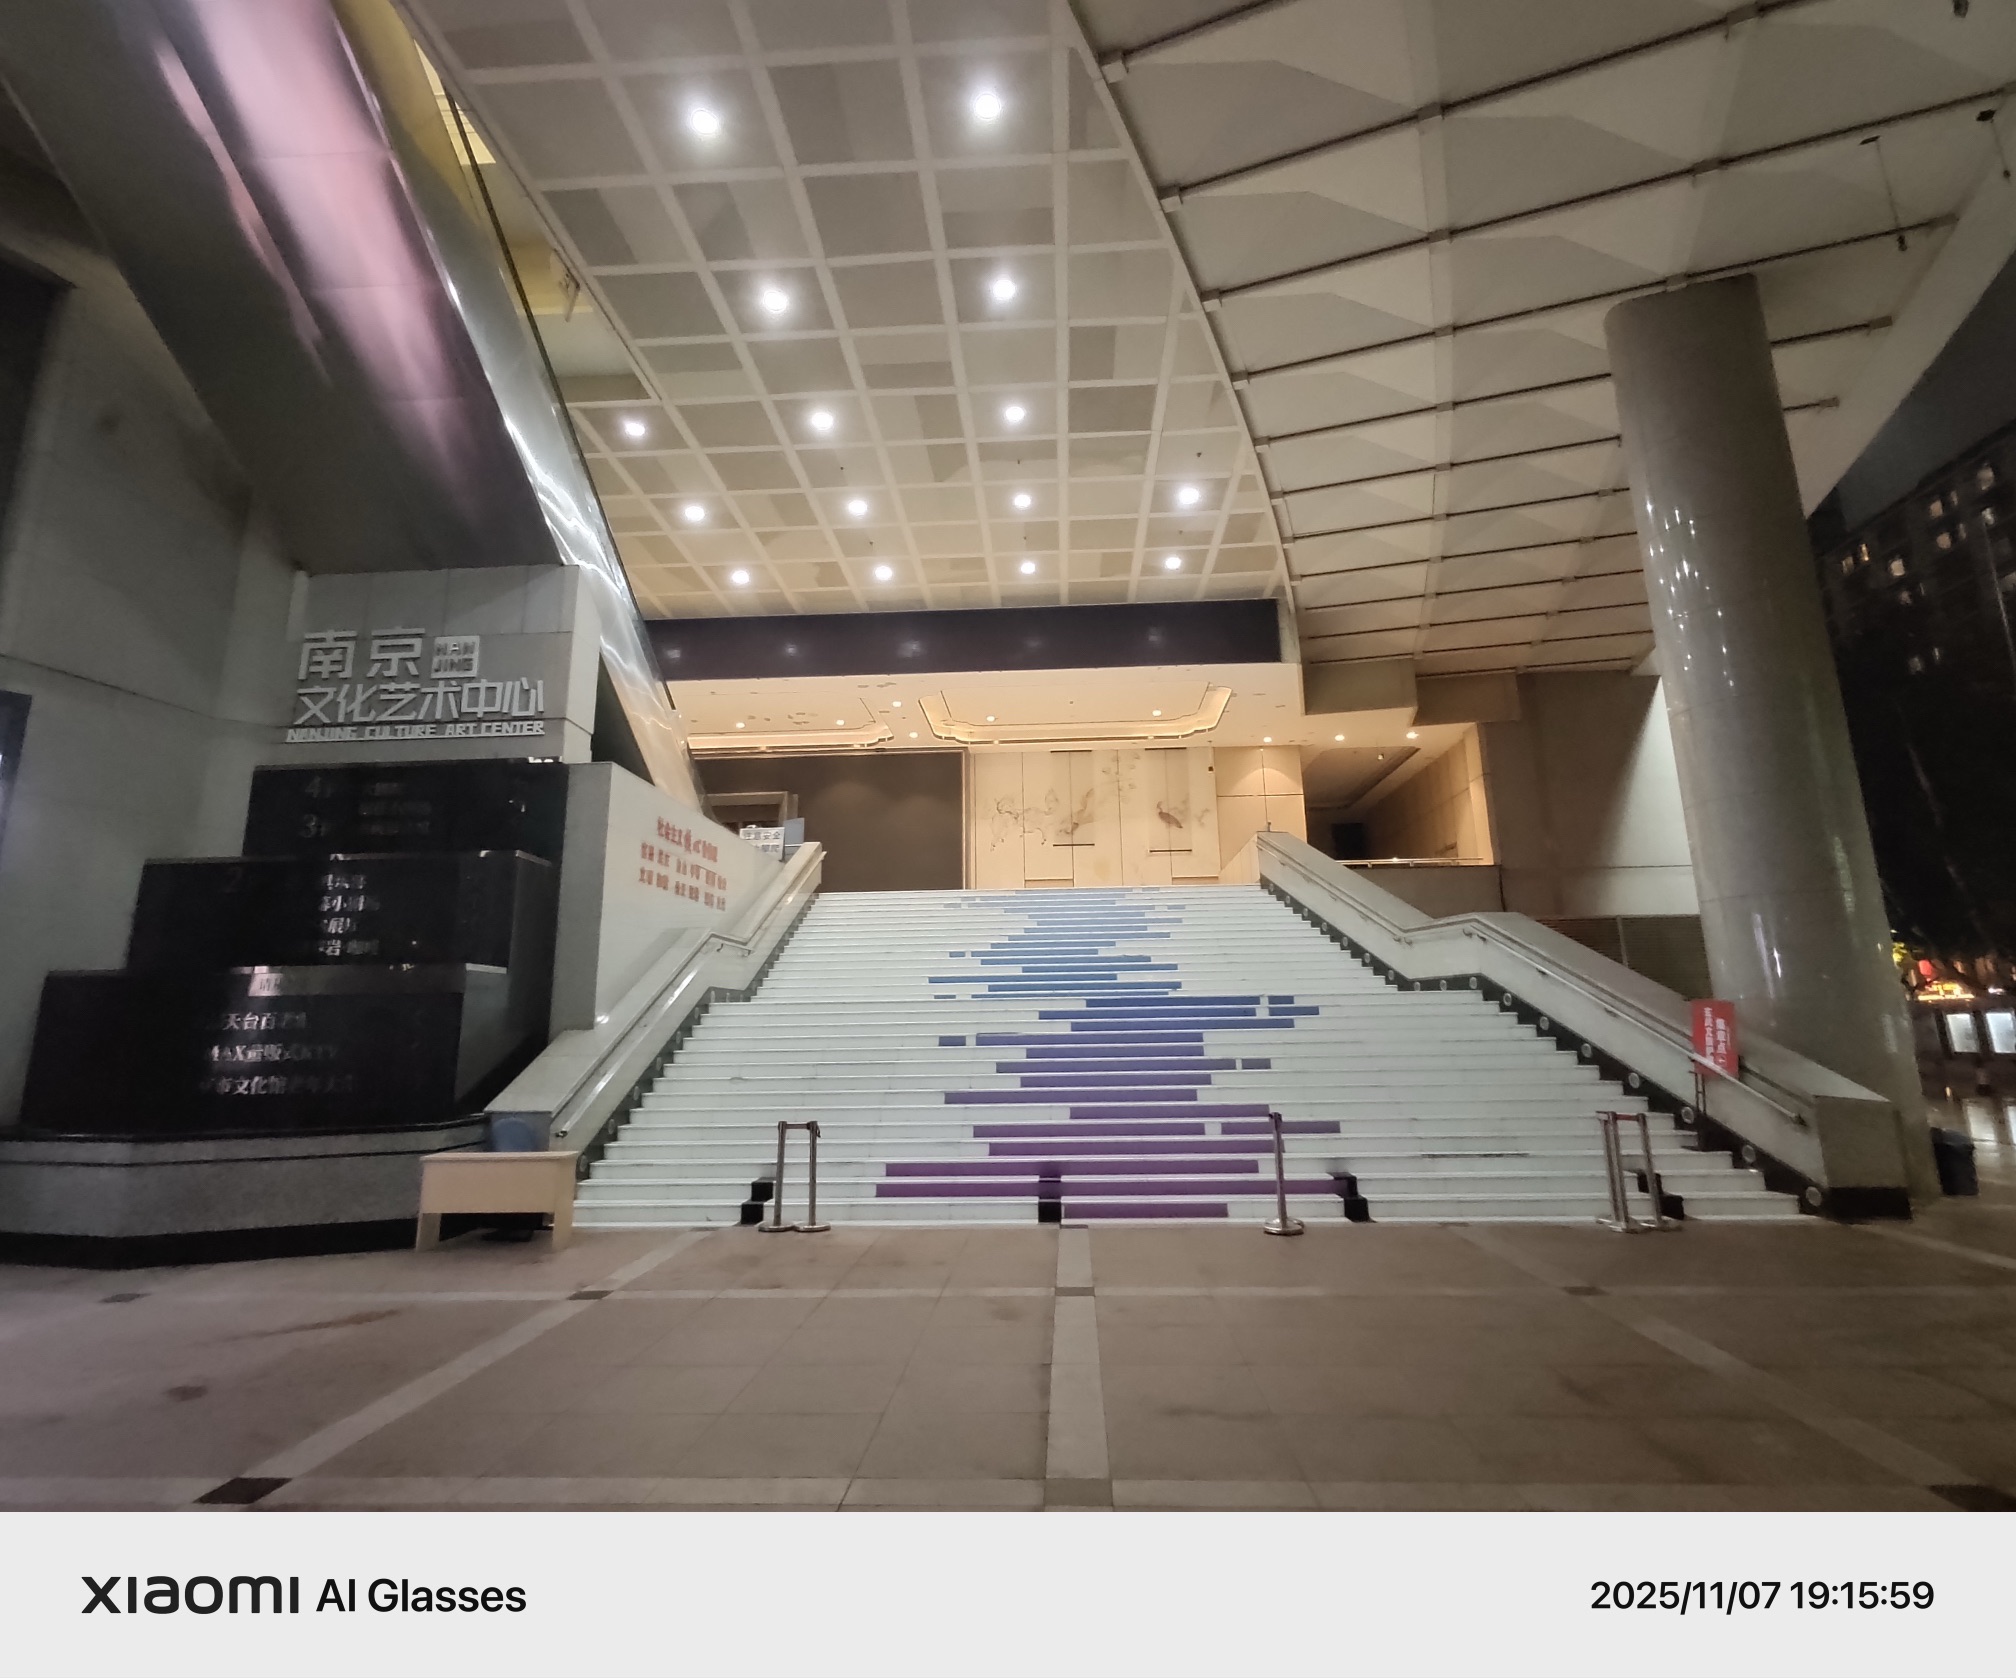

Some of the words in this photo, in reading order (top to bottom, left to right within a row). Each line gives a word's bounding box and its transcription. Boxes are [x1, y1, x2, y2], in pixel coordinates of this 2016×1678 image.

[297, 627, 426, 680] 南京
[293, 677, 545, 724] 文化艺术中心
[286, 726, 358, 742] NANJING
[365, 724, 437, 739] CULTURE
[446, 722, 478, 737] ART
[481, 720, 545, 736] CENTER
